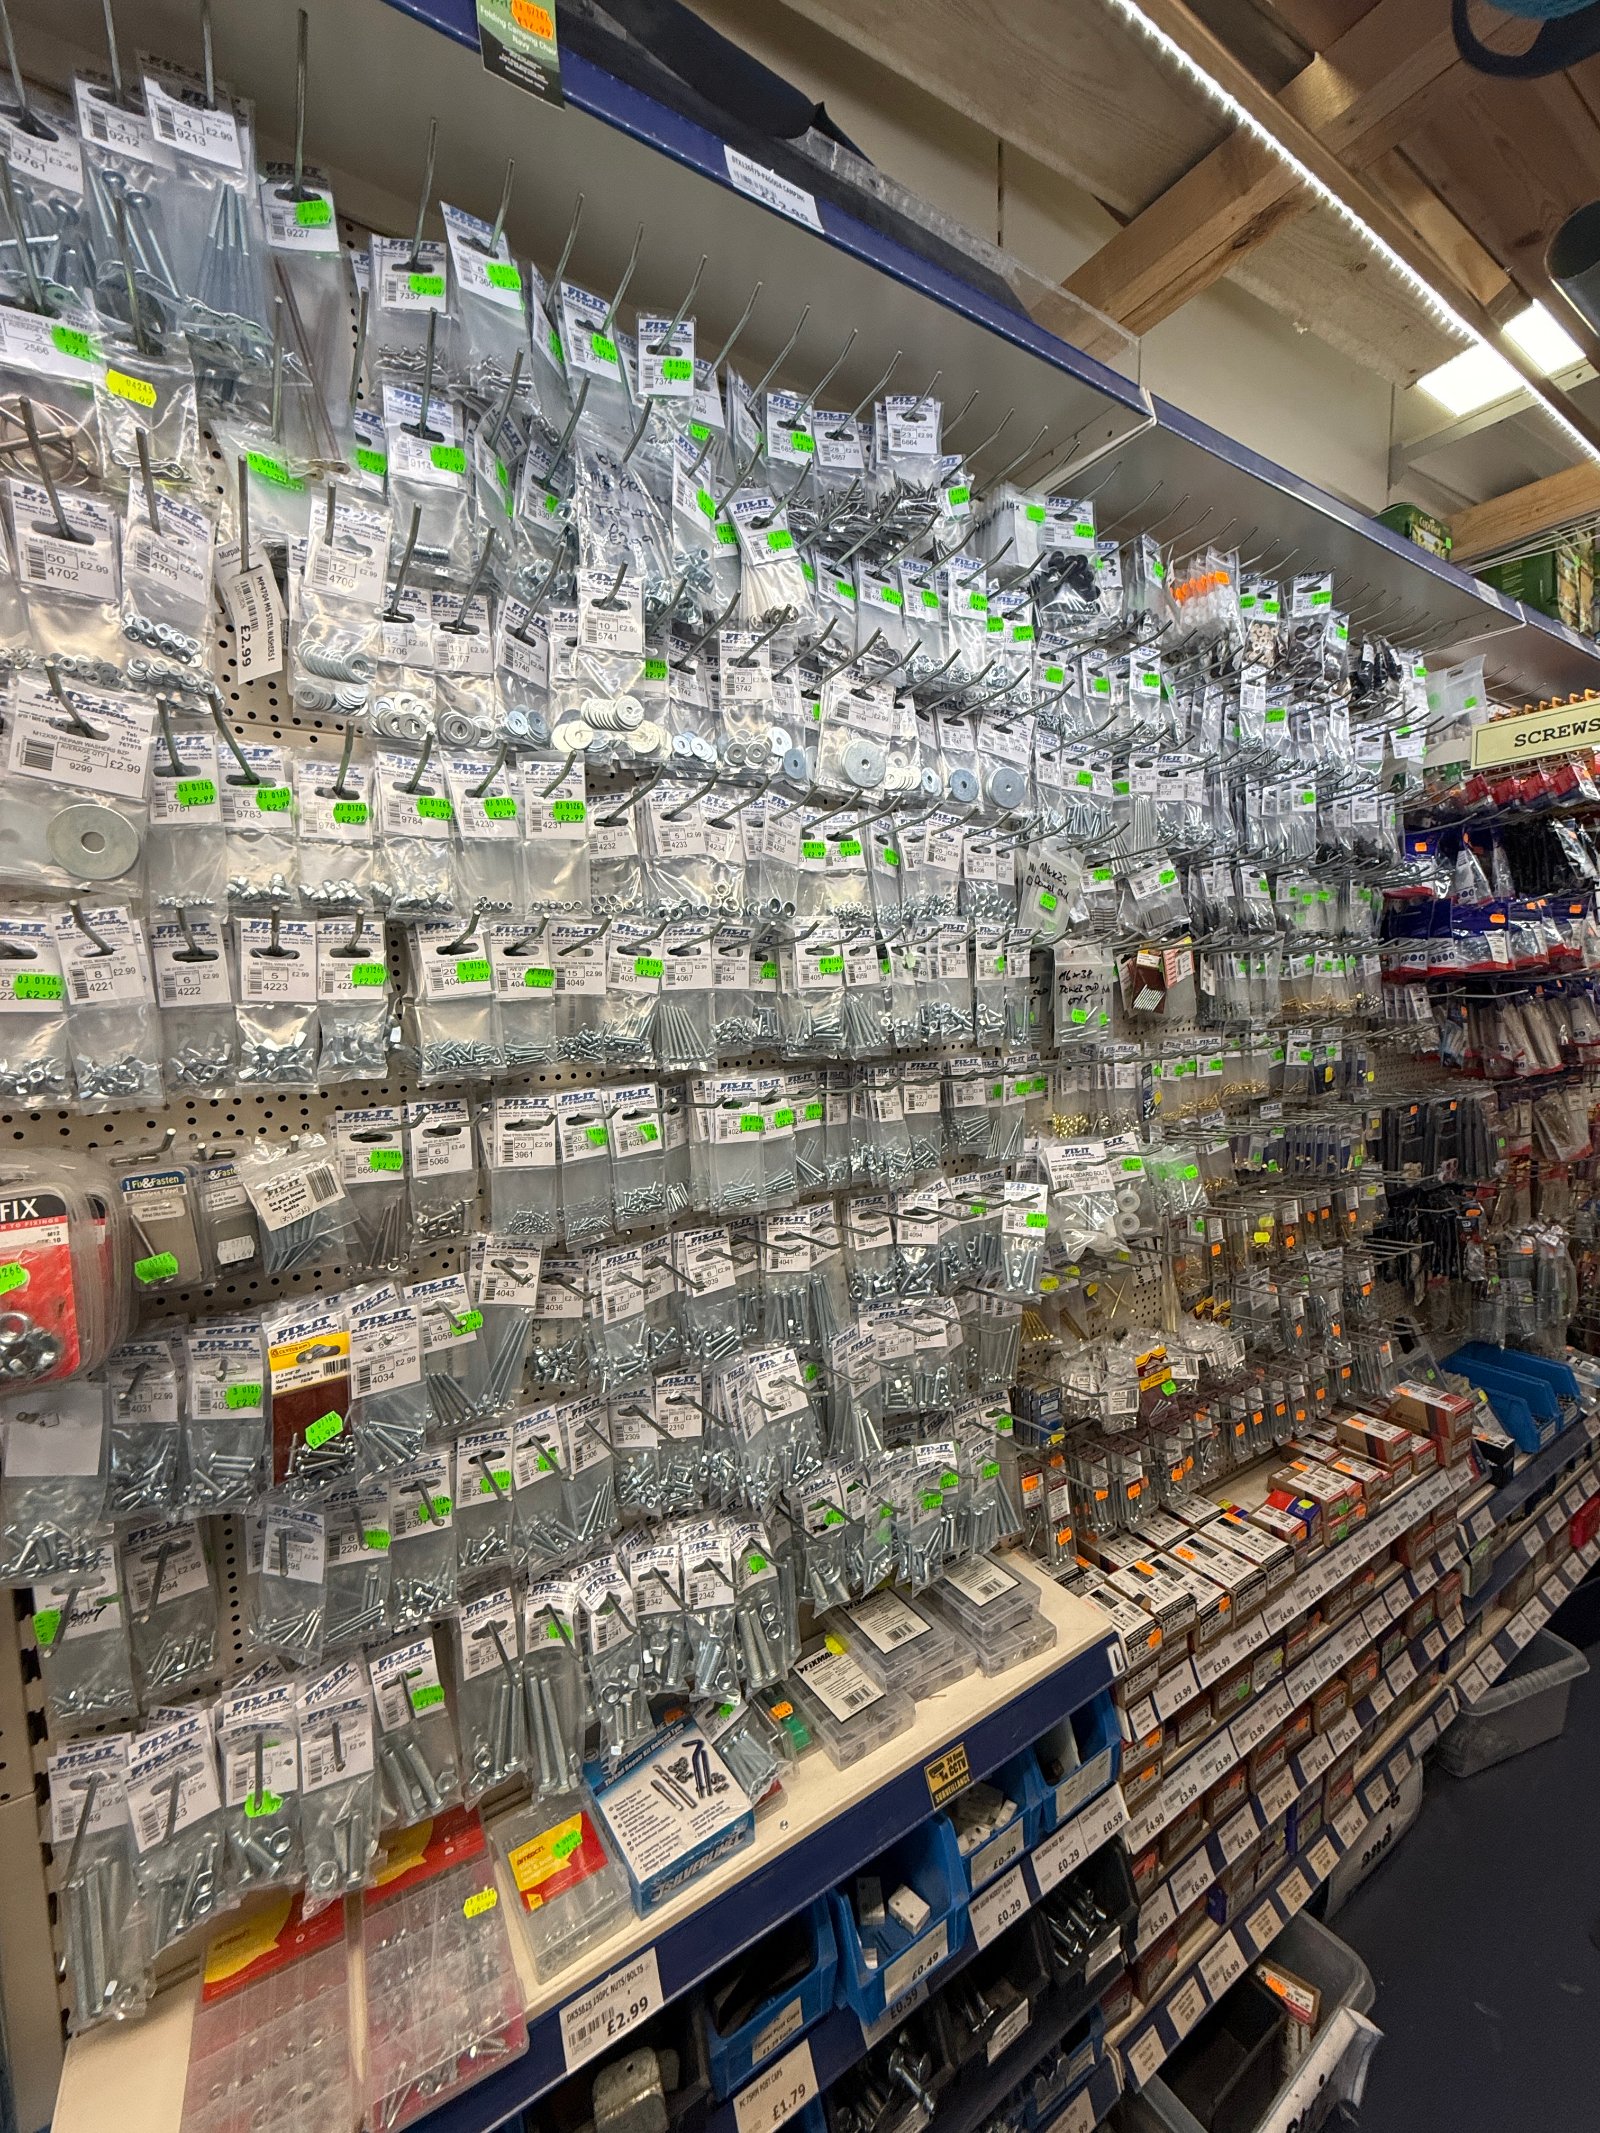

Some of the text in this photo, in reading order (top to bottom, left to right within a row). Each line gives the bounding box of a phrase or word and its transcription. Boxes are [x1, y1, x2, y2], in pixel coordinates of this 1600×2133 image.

[109, 130, 140, 149] 9212
[176, 127, 207, 148] 9213
[205, 127, 233, 143] £2.99
[286, 228, 310, 240] 9227
[47, 553, 66, 564] 50
[80, 561, 109, 575] £2.99
[331, 563, 346, 572] 12
[47, 567, 79, 581] 4702
[359, 568, 378, 578] £2.99
[265, 612, 275, 632] STEEL
[599, 622, 610, 631] 10
[598, 632, 617, 642] 5741
[240, 624, 253, 668] £2.99
[514, 660, 530, 674] 5740
[735, 675, 746, 684] 12
[735, 684, 752, 693] 5742
[1514, 717, 1600, 748] SCREWS
[83, 754, 91, 763] 2
[69, 762, 93, 774] 9299
[109, 759, 141, 775] £2.99
[242, 799, 251, 808] 6
[236, 809, 263, 819] 9783
[407, 806, 414, 814] 4
[478, 810, 486, 818] 6
[401, 815, 423, 826] 9784
[475, 819, 495, 829] 4230
[543, 821, 562, 830] 4231
[598, 841, 617, 851] 4232
[671, 841, 688, 849] 4233
[94, 970, 103, 979] 8
[113, 966, 137, 977] £2.99
[202, 971, 220, 980] £2.99
[271, 972, 279, 980] 5
[291, 970, 310, 979] £2.99
[442, 966, 456, 976] 20
[567, 969, 578, 978] 15
[586, 969, 603, 978] £2.99
[17, 976, 30, 985] 03
[182, 976, 191, 985] 6
[359, 975, 383, 985] £2.99
[465, 972, 489, 981] £2.99
[620, 973, 638, 983] 4051
[675, 974, 693, 982] 4067
[89, 982, 114, 992] 4221
[263, 982, 289, 992] 4223
[565, 979, 585, 987] 4049
[26, 989, 62, 1000] £2.99
[177, 986, 201, 996] 4222
[342, 1109, 393, 1121] FIX-IT
[534, 1141, 553, 1149] £2.99
[514, 1151, 533, 1159] 3961
[429, 1156, 449, 1166] 5066
[132, 1175, 179, 1189] Fix&Fasten
[3, 1197, 39, 1220] FIX
[495, 1289, 515, 1298] 4043
[545, 1303, 564, 1311] 4036
[358, 1308, 412, 1328] FIX-IT
[277, 1315, 330, 1340] FIX-IT
[395, 1356, 416, 1367] £2.99
[378, 1363, 387, 1372] 5
[372, 1372, 394, 1384] 4034
[153, 1391, 174, 1401] £2.99
[131, 1403, 152, 1414] 4031
[311, 1426, 336, 1446] £1.99
[1213, 1655, 1231, 1674] £3.99
[231, 1687, 288, 1713] FIX-IT
[1173, 1685, 1193, 1705] £3.99
[57, 1745, 116, 1767] FIX-IT
[949, 1757, 967, 1777] CCTV
[1103, 1811, 1124, 1835] £0.59
[993, 1846, 1016, 1870] £0.29
[1058, 1849, 1081, 1874] £0.29
[998, 1899, 1022, 1926] £0.29
[912, 1951, 940, 1982] £0.49
[610, 1963, 645, 1994] NUTS/BOLTS
[607, 1996, 649, 2037] £2.99
[772, 2083, 806, 2122] £1.79
